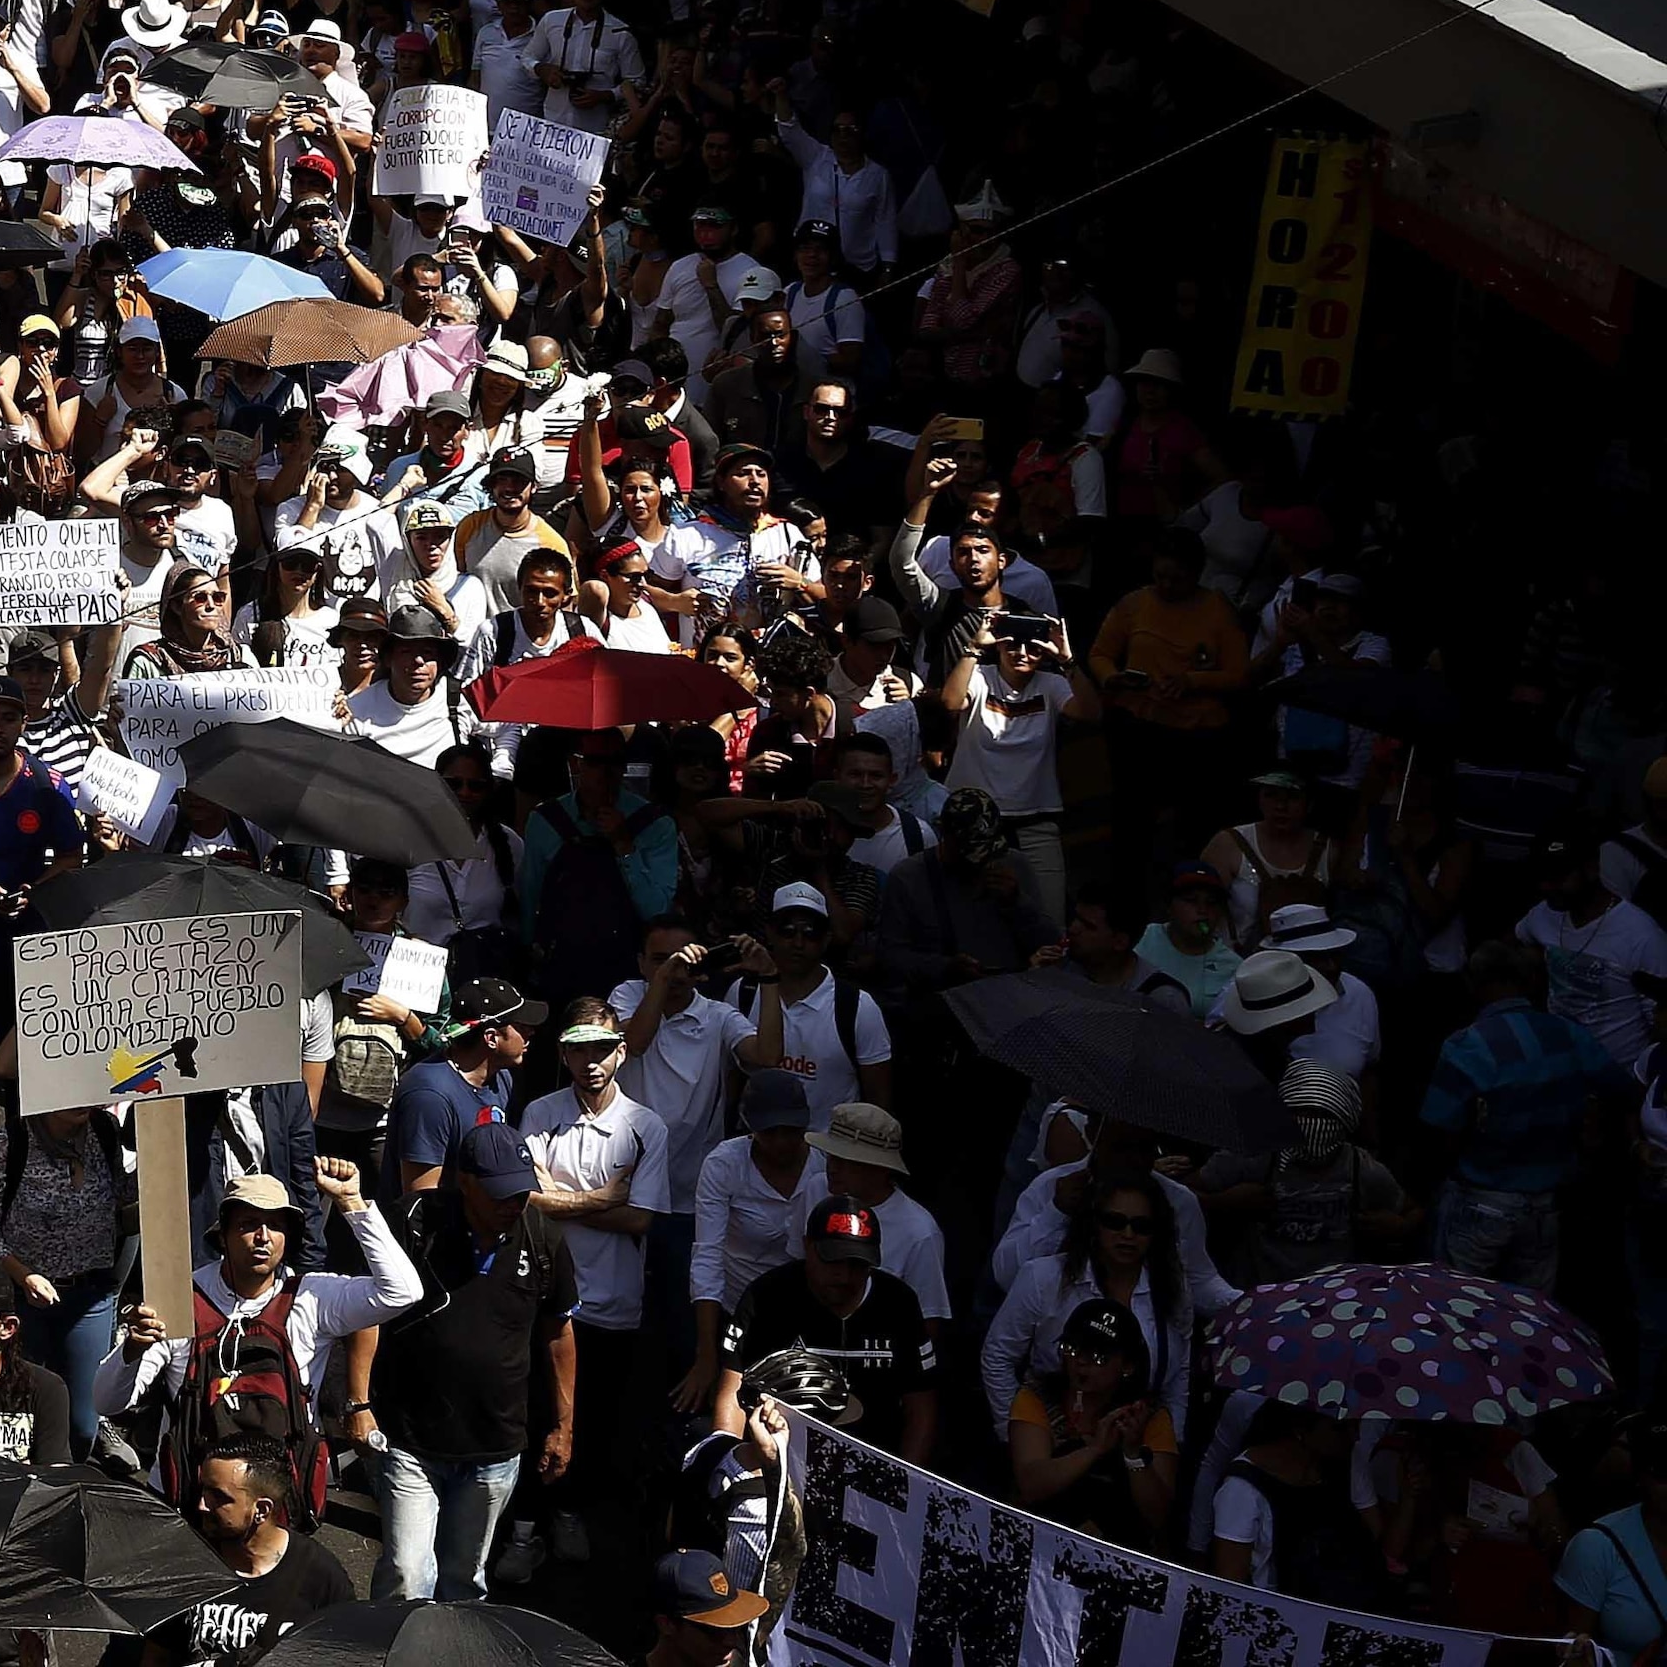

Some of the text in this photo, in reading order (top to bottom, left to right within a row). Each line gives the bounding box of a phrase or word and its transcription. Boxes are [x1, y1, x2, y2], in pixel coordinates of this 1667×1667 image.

[384, 130, 465, 149] FUERA DUQUE
[498, 113, 595, 161] SE METIERON
[383, 149, 463, 170] SU TITIRITERO
[1244, 148, 1323, 398] HORA
[59, 522, 94, 547] QUE
[97, 522, 118, 546] MI
[50, 548, 108, 570] COLAPSE
[57, 571, 93, 590] PERO
[96, 569, 116, 587] TU
[48, 605, 69, 623] MI
[76, 588, 120, 624] PAÍS
[127, 682, 334, 713] PARA EL PRESIDENTE
[127, 717, 181, 742] PARA
[133, 746, 179, 767] COMO
[19, 913, 291, 963] ESTO NO ES UN
[69, 936, 258, 981] PAQUETAZO
[19, 959, 266, 1014] ES UN CRIMEN
[21, 981, 286, 1040] CONTRA EL PUEBLO
[41, 1010, 237, 1060] COLOMBIANO
